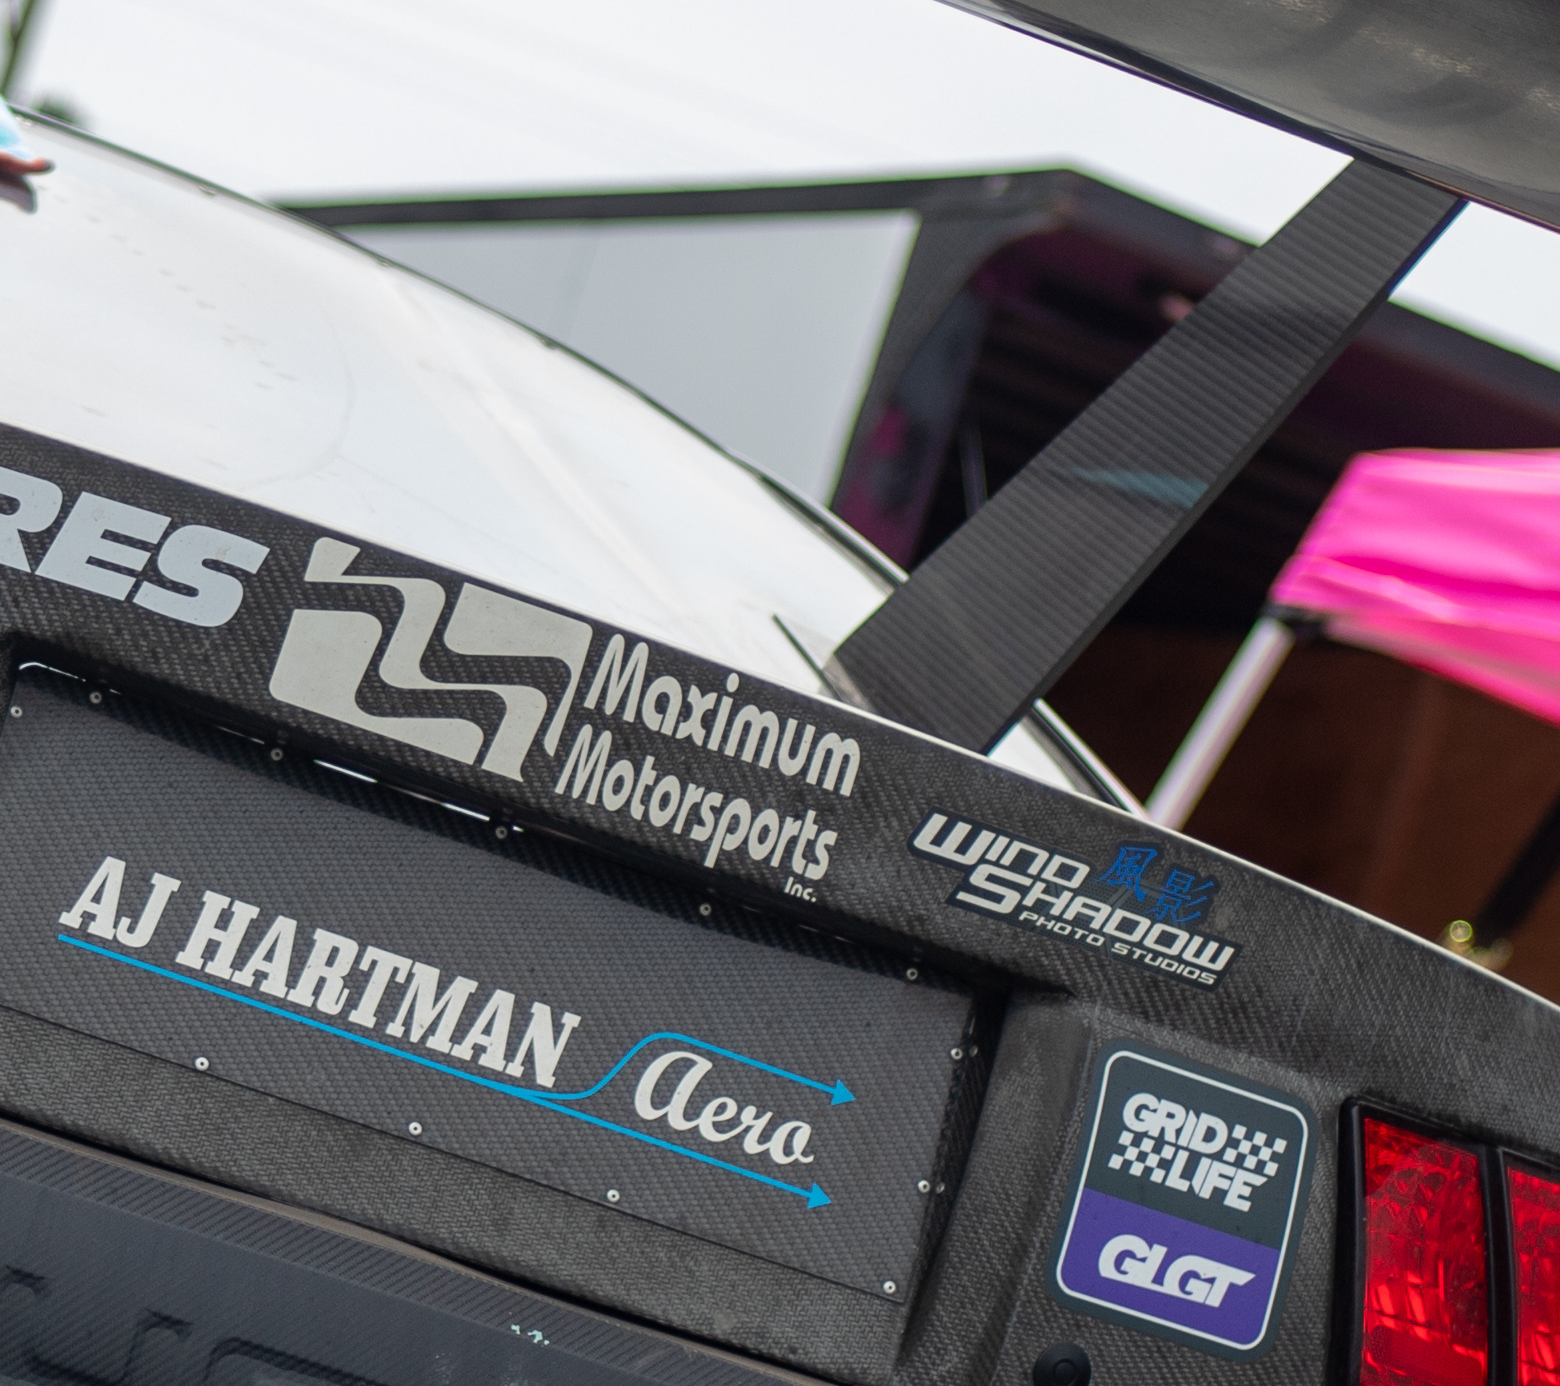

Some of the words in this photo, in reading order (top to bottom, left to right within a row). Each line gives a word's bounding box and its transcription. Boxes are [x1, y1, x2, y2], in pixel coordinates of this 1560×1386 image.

[582, 633, 861, 798] Maximum
[555, 723, 837, 883] Motorsports
[783, 875, 818, 903] Inc.
[956, 864, 1235, 971] SHADOW
[1097, 845, 1215, 924] 風影
[1019, 911, 1106, 947] PHOTO
[1111, 942, 1218, 985] STUDIOS
[58, 855, 182, 950] AJ
[175, 889, 582, 1091] HARTMAN
[633, 1049, 815, 1168] Aero
[1123, 1092, 1229, 1155] GRID
[1165, 1149, 1268, 1212] LIFE
[1098, 1233, 1256, 1308] GLGT
